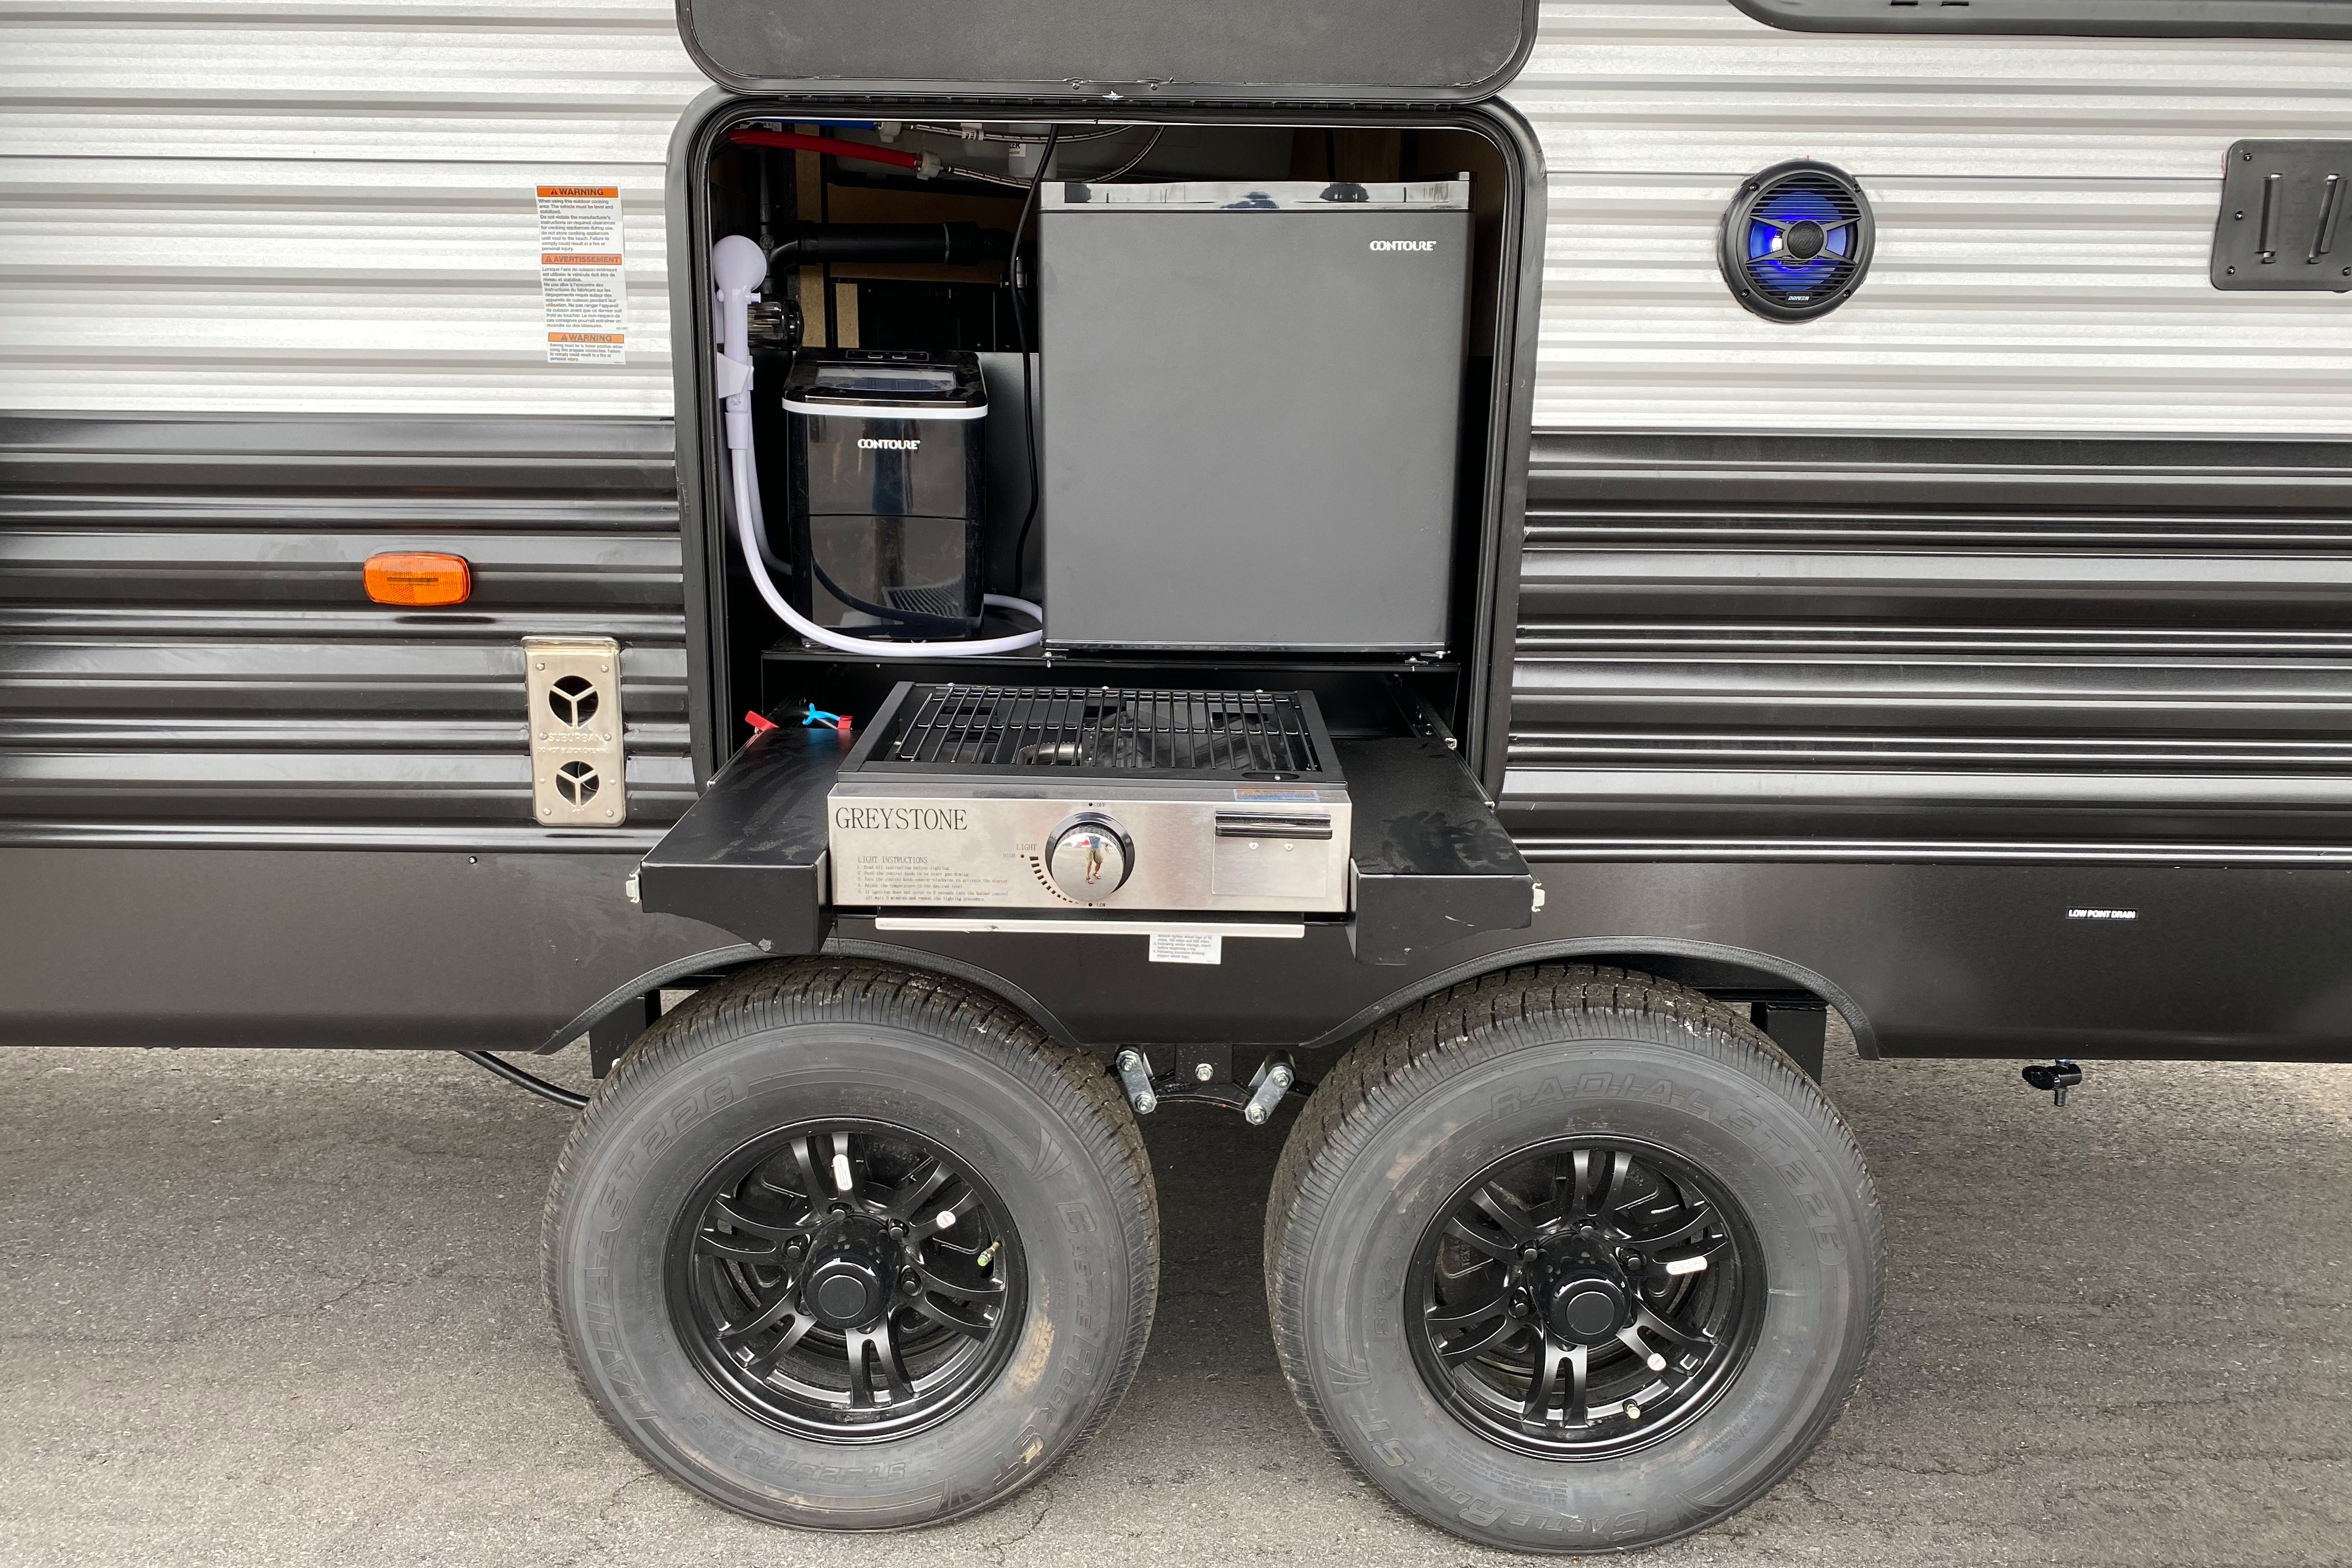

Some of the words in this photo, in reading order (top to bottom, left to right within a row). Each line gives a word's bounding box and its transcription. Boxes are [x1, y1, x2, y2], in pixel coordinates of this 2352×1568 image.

[1369, 240, 1434, 251] CONTOURE
[569, 334, 612, 342] WARNING
[857, 439, 918, 450] CONTOURE
[836, 807, 968, 831] GREYSTONE
[1491, 1072, 1711, 1119] RADIAL
